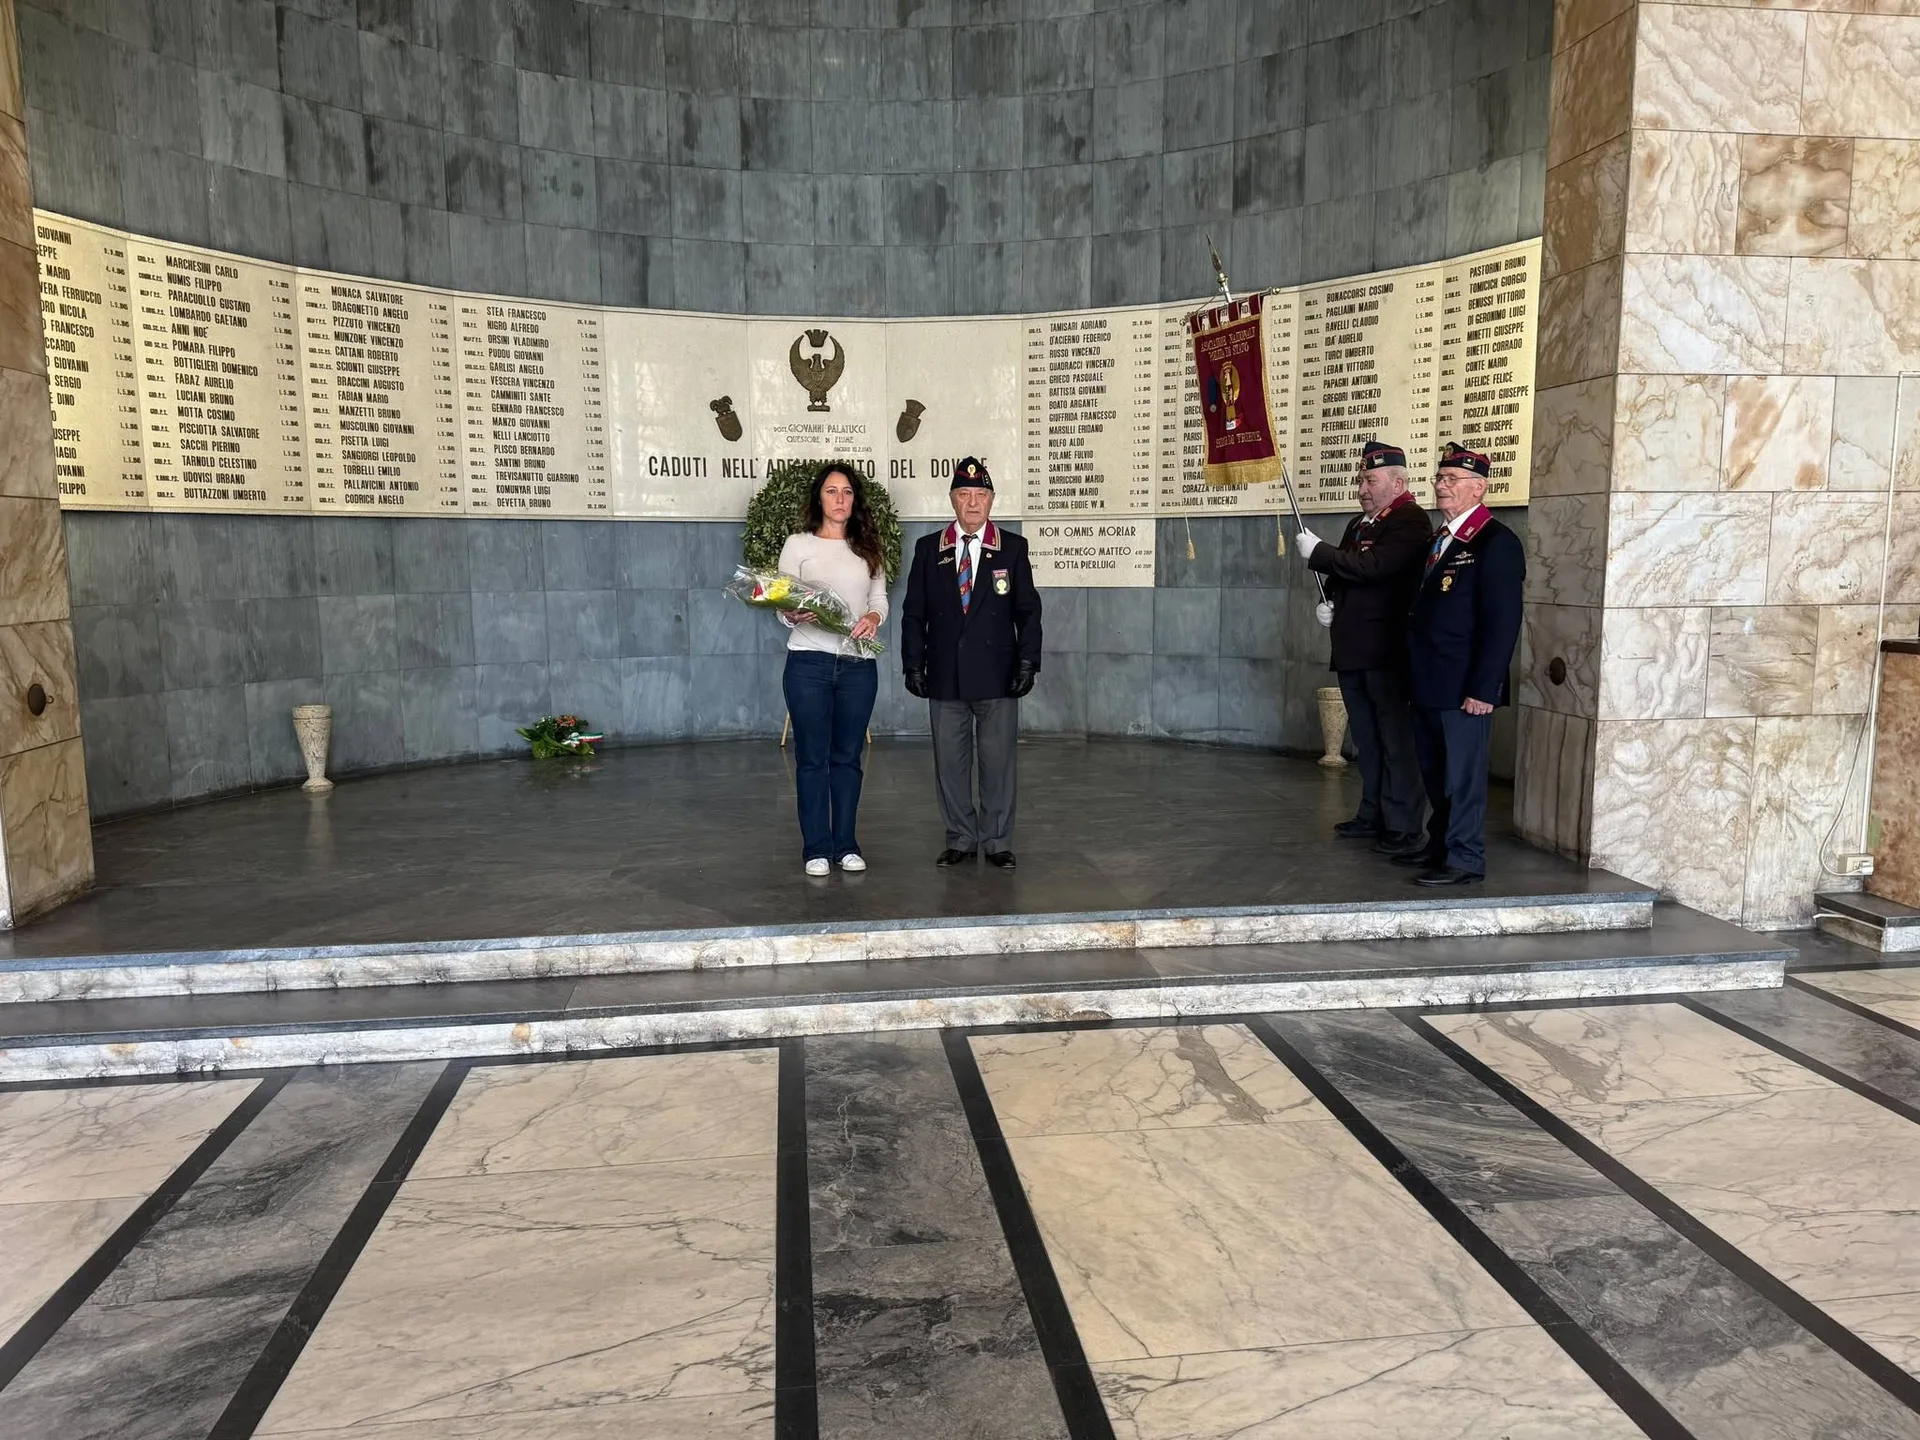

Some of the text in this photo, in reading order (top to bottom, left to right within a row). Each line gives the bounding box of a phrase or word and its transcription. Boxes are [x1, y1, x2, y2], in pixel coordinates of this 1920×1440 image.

[36, 225, 71, 246] GIOVANNI
[45, 263, 70, 282] MARIO
[165, 255, 211, 274] MARCHESINI
[214, 263, 238, 279] CARLO
[1469, 255, 1526, 278] PASTORINI BRUNO
[166, 272, 191, 287] NUMIS
[194, 276, 222, 292] FILIPPO
[1500, 271, 1526, 288] GIORGIO
[61, 284, 102, 305] FERRUCCIO
[330, 285, 362, 300] MONACA
[365, 289, 403, 305] SALVATORE
[1326, 286, 1366, 303] BONACCORSI
[1368, 282, 1393, 296] COSIMO
[167, 289, 216, 307] PARACUOLLO
[219, 296, 251, 313] GUSTAVO
[1358, 299, 1378, 313] MARIO
[59, 302, 87, 320] NICOLA
[169, 305, 211, 323] LOMBARDO
[214, 312, 247, 328] GAETANO
[331, 300, 378, 316] DRAGONETTO
[382, 306, 408, 320] ANGELO
[486, 305, 504, 317] STEA
[507, 307, 546, 321] FRANCESCO
[1467, 304, 1525, 326] DI GERONIMO LUIGI
[50, 318, 94, 339] FRANCESCO
[170, 322, 189, 336] ANNI
[332, 315, 400, 334] PIZZUTO VINCENZO
[486, 319, 539, 334] NIGRO ALFREDO
[1049, 321, 1077, 332] TAMISARI
[1080, 319, 1107, 330] ADRIANO
[1325, 314, 1378, 332] RAVELLI CLAUDIO
[1082, 332, 1111, 343] FEDERICO
[1466, 321, 1524, 341] MINETTI GIUSEPPE
[333, 330, 403, 348] MUNZONE VINCENZO
[487, 333, 549, 348] ORSINI VLADIMIRO
[172, 339, 235, 358] POMARA FILIPPO
[1049, 346, 1100, 358] RUSSO VINCENZO
[53, 355, 89, 373] GIOVANNI
[173, 355, 258, 376] BOTTIGLIERI DOMENICO
[335, 360, 400, 376] SCIONTI GIUSEPPE
[1049, 358, 1114, 371] QUADRACCI VINCENZO
[1323, 359, 1374, 375] LEBAN VITTORIO
[1465, 355, 1508, 372] CONTE MARIO
[54, 373, 81, 390] SERGIO
[174, 372, 234, 389] FABAZ AURELIO
[490, 375, 554, 389] VESCERA VINCENZO
[1323, 373, 1378, 389] PAPAGNI ANTONIO
[337, 390, 388, 404] FABIAN MARIO
[1049, 384, 1106, 396] BATTISTA GIOVANNI
[1463, 384, 1528, 403] MORABITO GIUSEPPE
[56, 392, 75, 406] DINO
[177, 405, 235, 421] MOTTA COSIMO
[338, 404, 401, 419] MANZETTI BRUNO
[491, 402, 564, 416] GENNARO FRANCESCO
[1048, 410, 1116, 422] GIUFFRIDA FRANCESCO
[1462, 402, 1519, 419] PICOZZA ANTONIO
[178, 421, 260, 439] PISCIOTTA SALVATORE
[339, 419, 414, 434] MUSCOLINO GIOVANNI
[492, 416, 550, 429] MANZO GIOVANNI
[788, 424, 824, 433] GIOVANNI
[827, 424, 866, 434] PALATUCCI
[1321, 416, 1388, 432] PETERNELLI UMBERTO
[492, 430, 550, 442] NELLI LANCIOTTO
[1048, 437, 1084, 447] NOLFO ALDO
[1494, 433, 1519, 447] COSIMO
[179, 438, 240, 453] SACCHI PIERINO
[520, 445, 555, 456] BERNARDO
[341, 449, 416, 463] SANGIORGI LEOPOLDO
[1320, 448, 1346, 460] SCIMONE
[181, 454, 257, 470] TARNOLD CELESTINO
[648, 456, 707, 477] CADUTI
[721, 457, 759, 479] NELL'
[890, 459, 915, 478] DEL
[1319, 461, 1352, 473] VITALIANO
[342, 464, 400, 476] TORBELLI EMILIO
[495, 470, 543, 481] TREVISANUTTO
[58, 481, 86, 495] FILIPPO
[343, 478, 419, 491] PALLAVICINI ANTONIO
[533, 485, 550, 495] LUIGI
[1079, 487, 1098, 496] MARIO
[183, 486, 266, 501] BUTTAZZONI UMBERTO
[344, 493, 404, 505] CODRICH ANGELO
[1207, 496, 1238, 505] VINCENZO
[528, 498, 551, 508] BRUNO
[1070, 500, 1088, 509] EDDIE
[1039, 526, 1136, 537] NON OMNIS MORIAR
[1054, 547, 1096, 556] DEMENEGO
[1098, 546, 1132, 556] MATTEO
[1054, 560, 1116, 569] ROTTA PIERLUIGI
